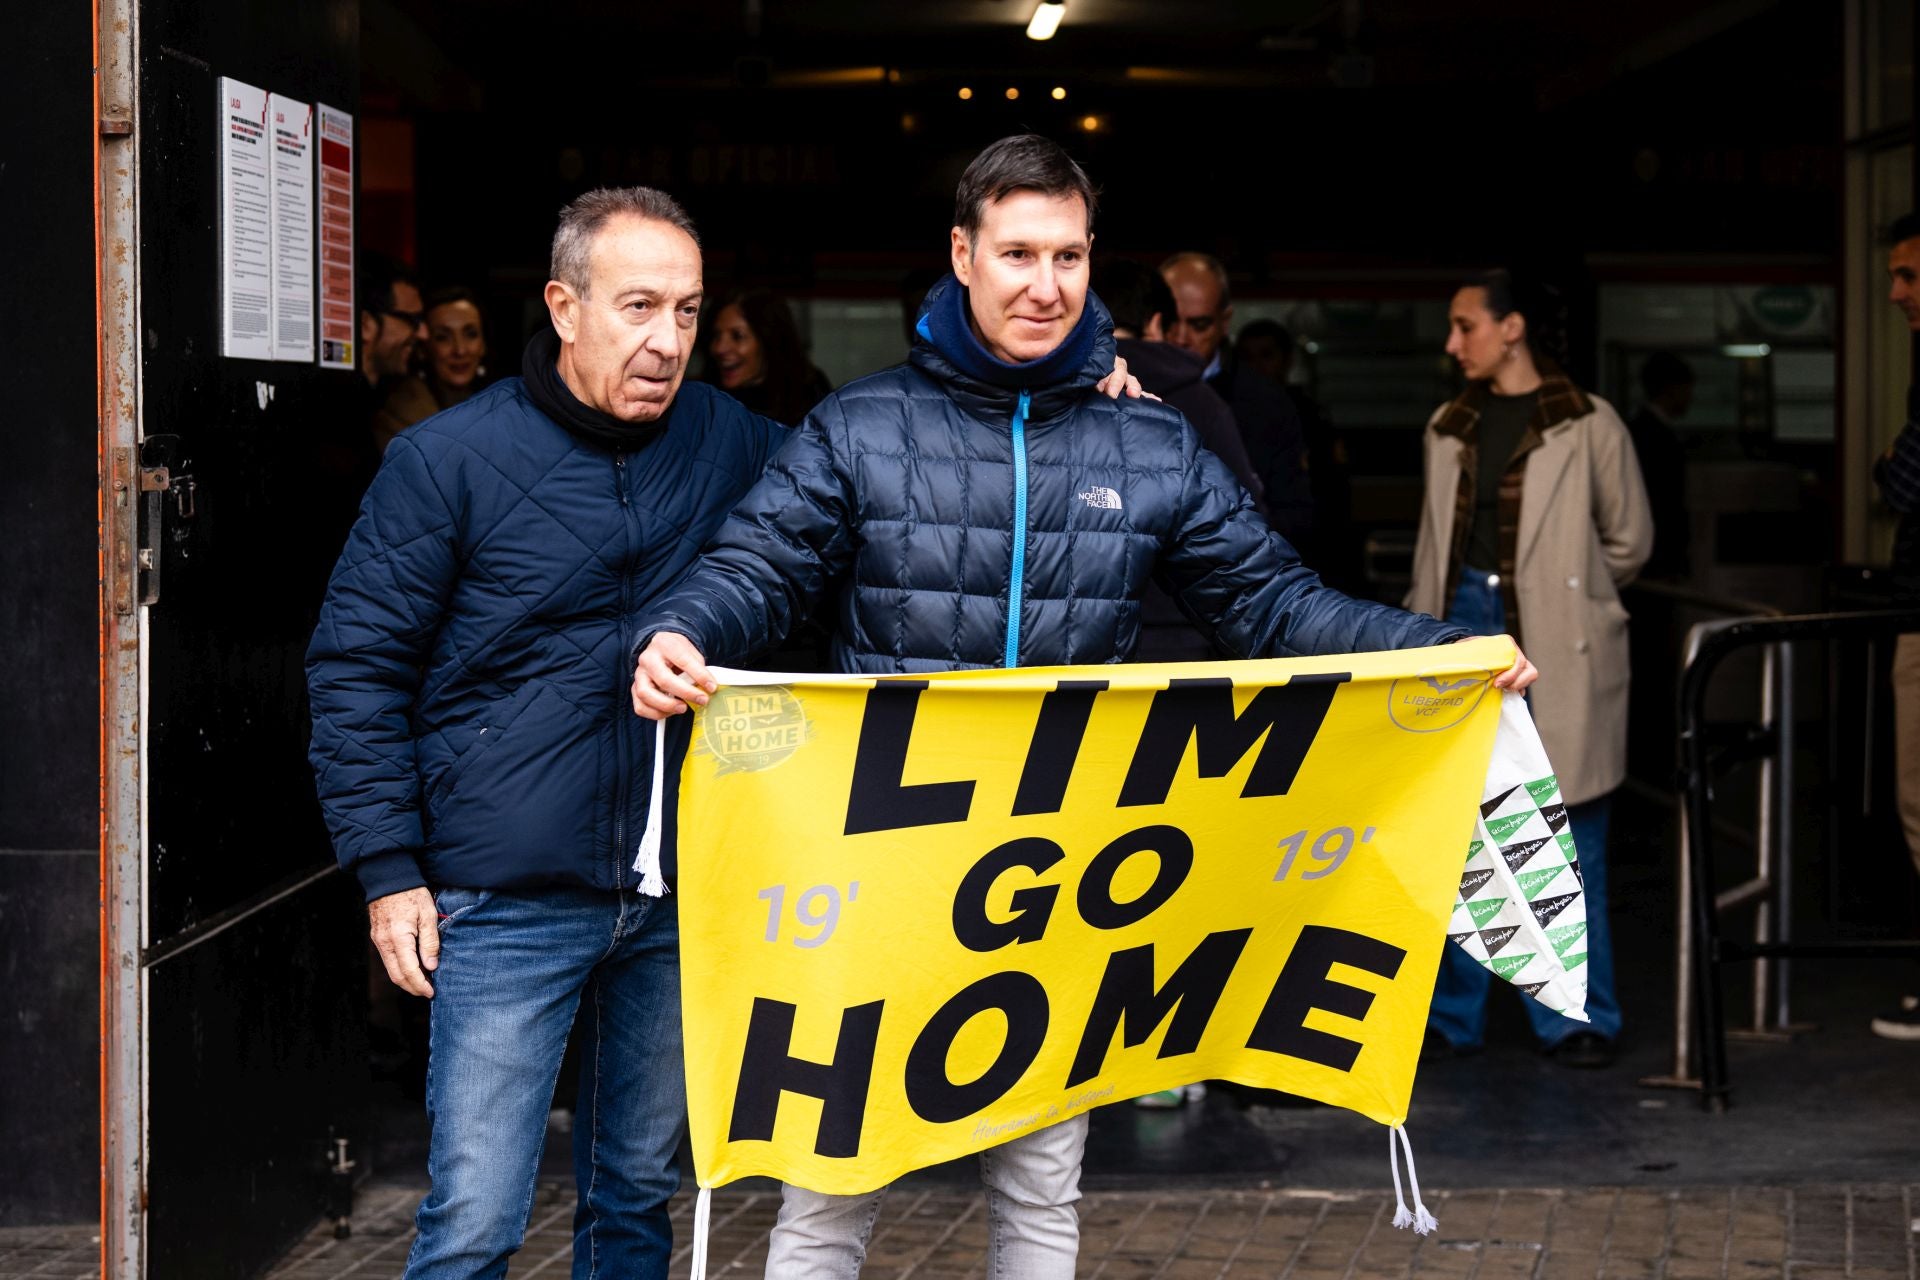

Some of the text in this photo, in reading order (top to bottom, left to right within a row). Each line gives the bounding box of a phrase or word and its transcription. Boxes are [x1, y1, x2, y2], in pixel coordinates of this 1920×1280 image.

[1079, 493, 1108, 501] NORTH
[1091, 486, 1107, 494] THE
[1087, 500, 1109, 508] FACE
[734, 697, 774, 714] LIM
[1403, 694, 1464, 706] LIBERTAD
[1416, 708, 1440, 716] VCF
[719, 718, 747, 732] GO
[727, 727, 799, 752] HOME
[844, 672, 1352, 837] LIM
[952, 824, 1194, 953] GO
[728, 924, 1408, 1158] HOME
[972, 1112, 1040, 1143] Honramos
